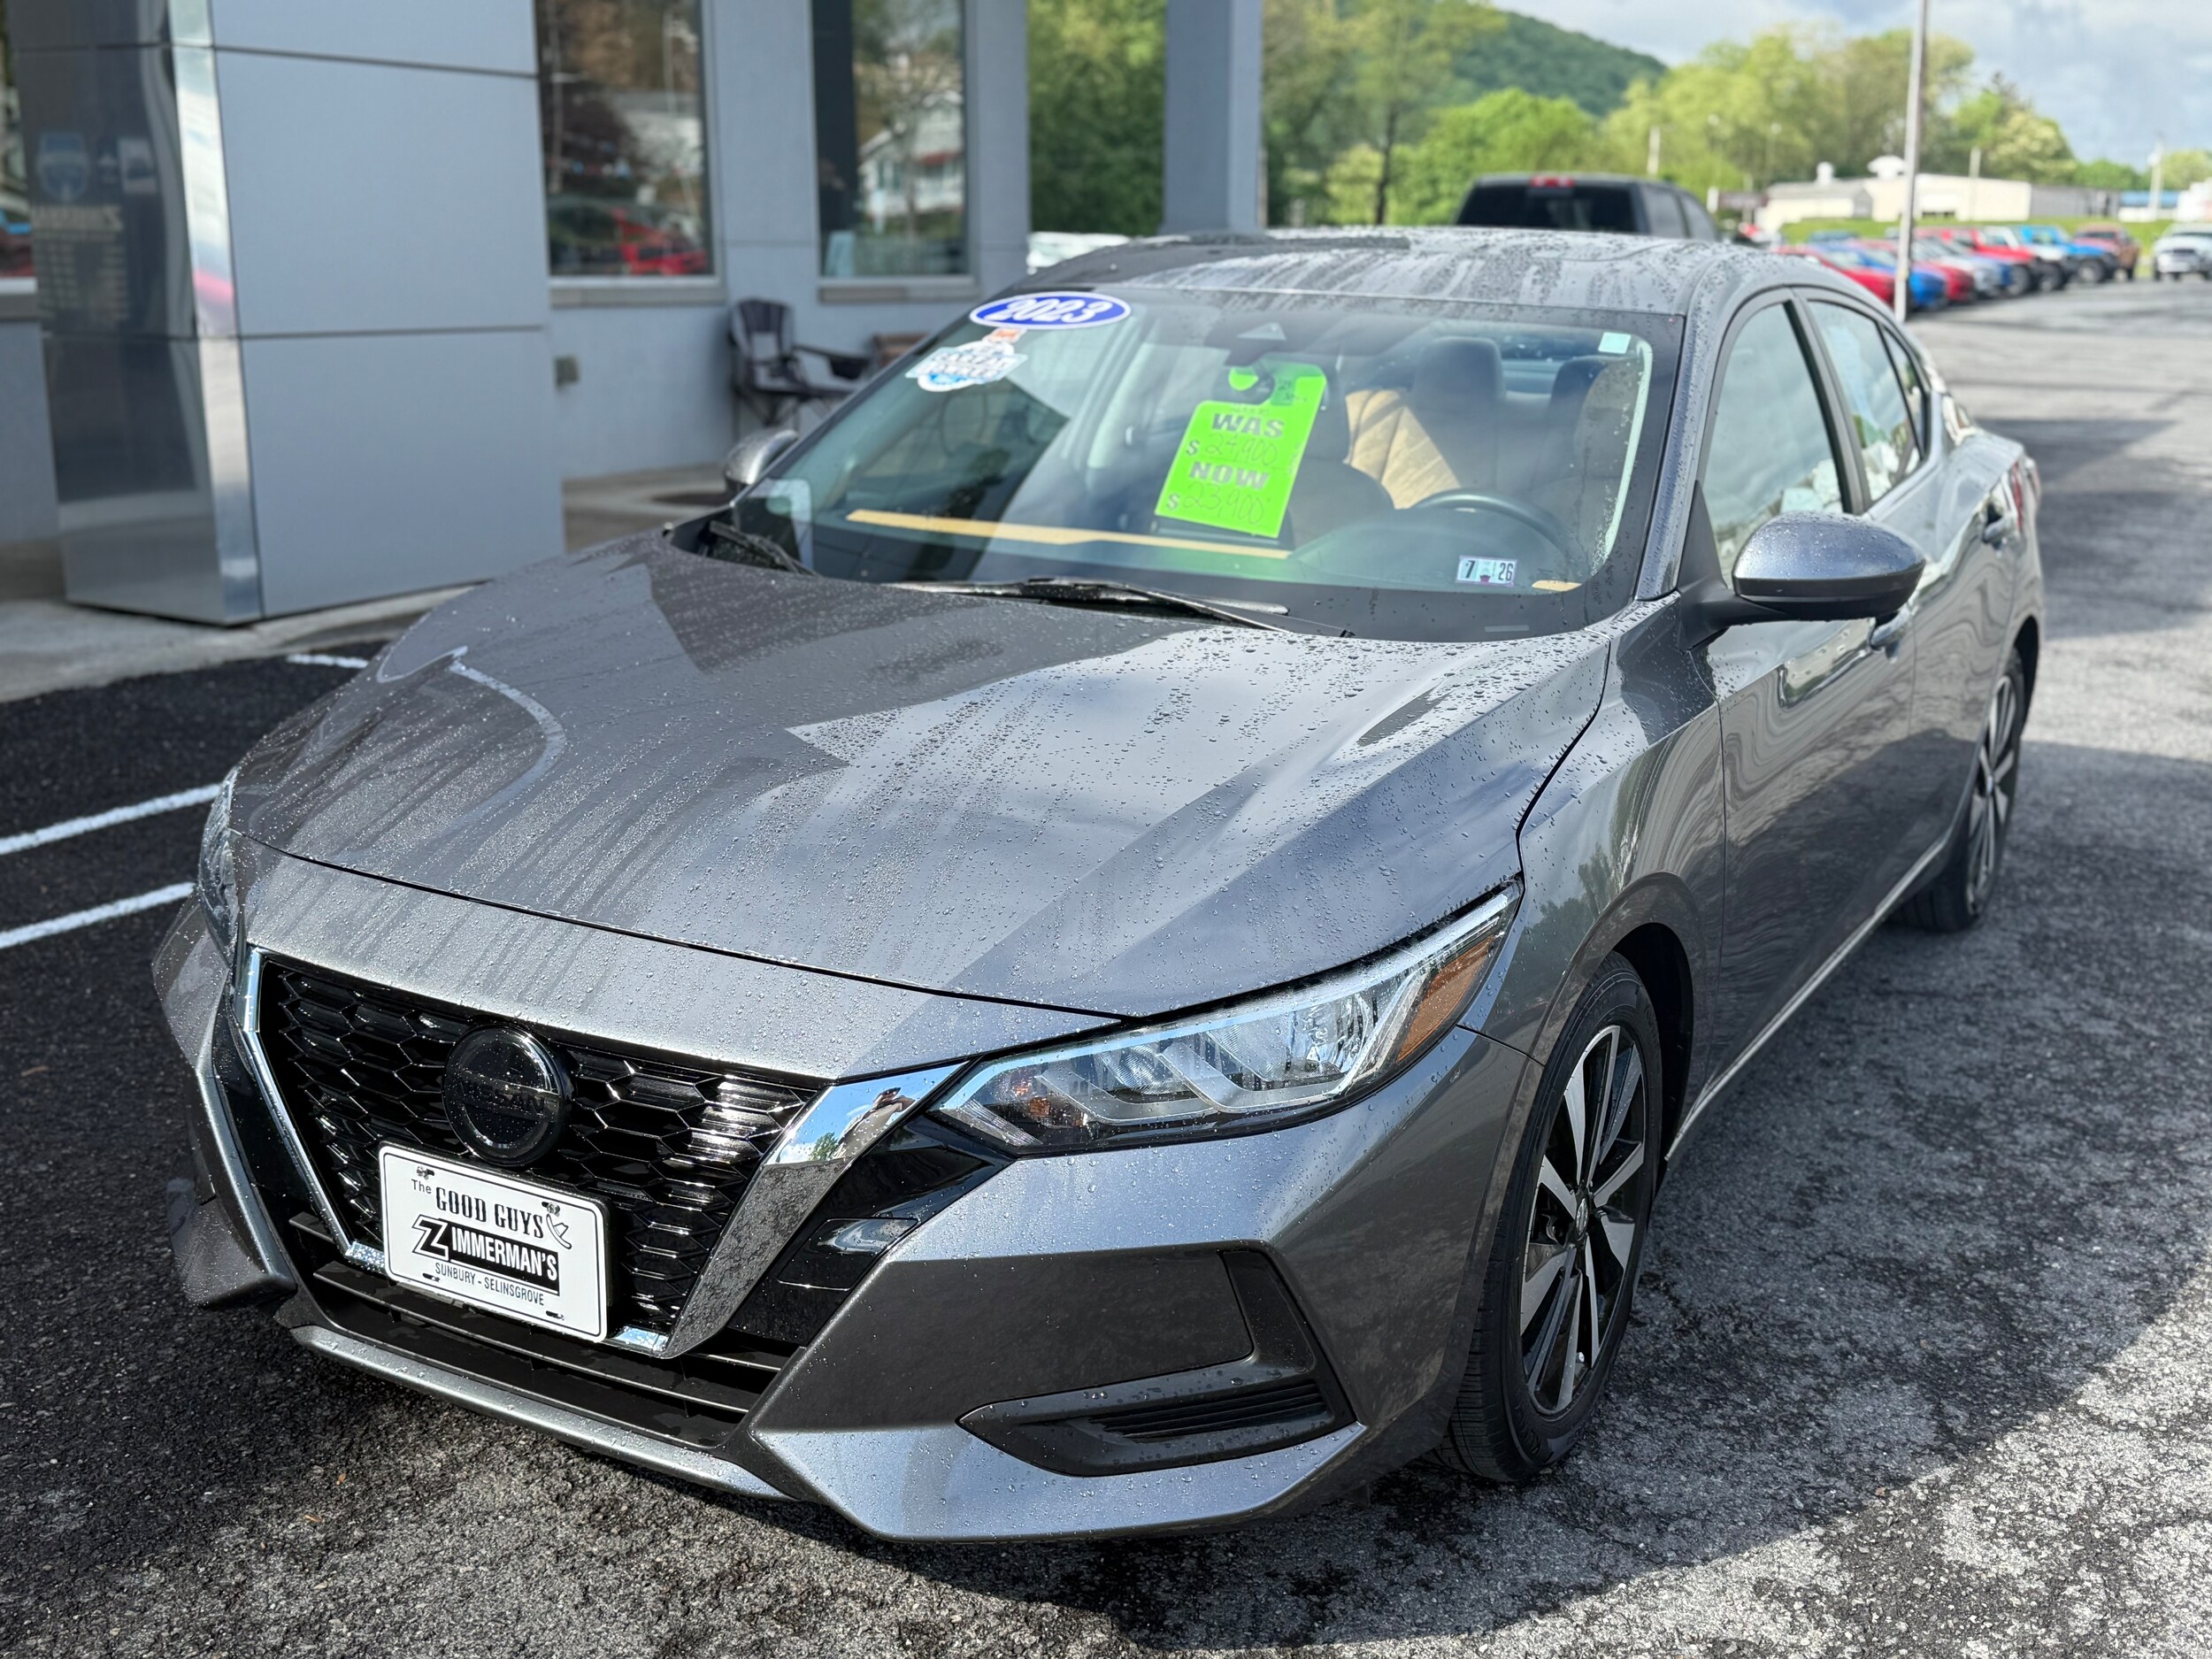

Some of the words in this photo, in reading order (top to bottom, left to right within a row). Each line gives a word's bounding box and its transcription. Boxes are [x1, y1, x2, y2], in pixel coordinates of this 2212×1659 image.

[984, 298, 1112, 323] 2023
[1212, 413, 1285, 438] WAS
[1187, 440, 1200, 456] $
[1189, 461, 1270, 490] NOW
[1166, 493, 1180, 511] $
[1465, 559, 1476, 579] 7
[1498, 562, 1514, 581] 26
[411, 1179, 432, 1194] The
[435, 1187, 488, 1223] GOOD
[495, 1204, 544, 1239] GUYS
[411, 1214, 558, 1281] ZIMMERMAN'S
[434, 1262, 476, 1286] SUNBURY
[484, 1277, 544, 1306] SELINSGROVE
